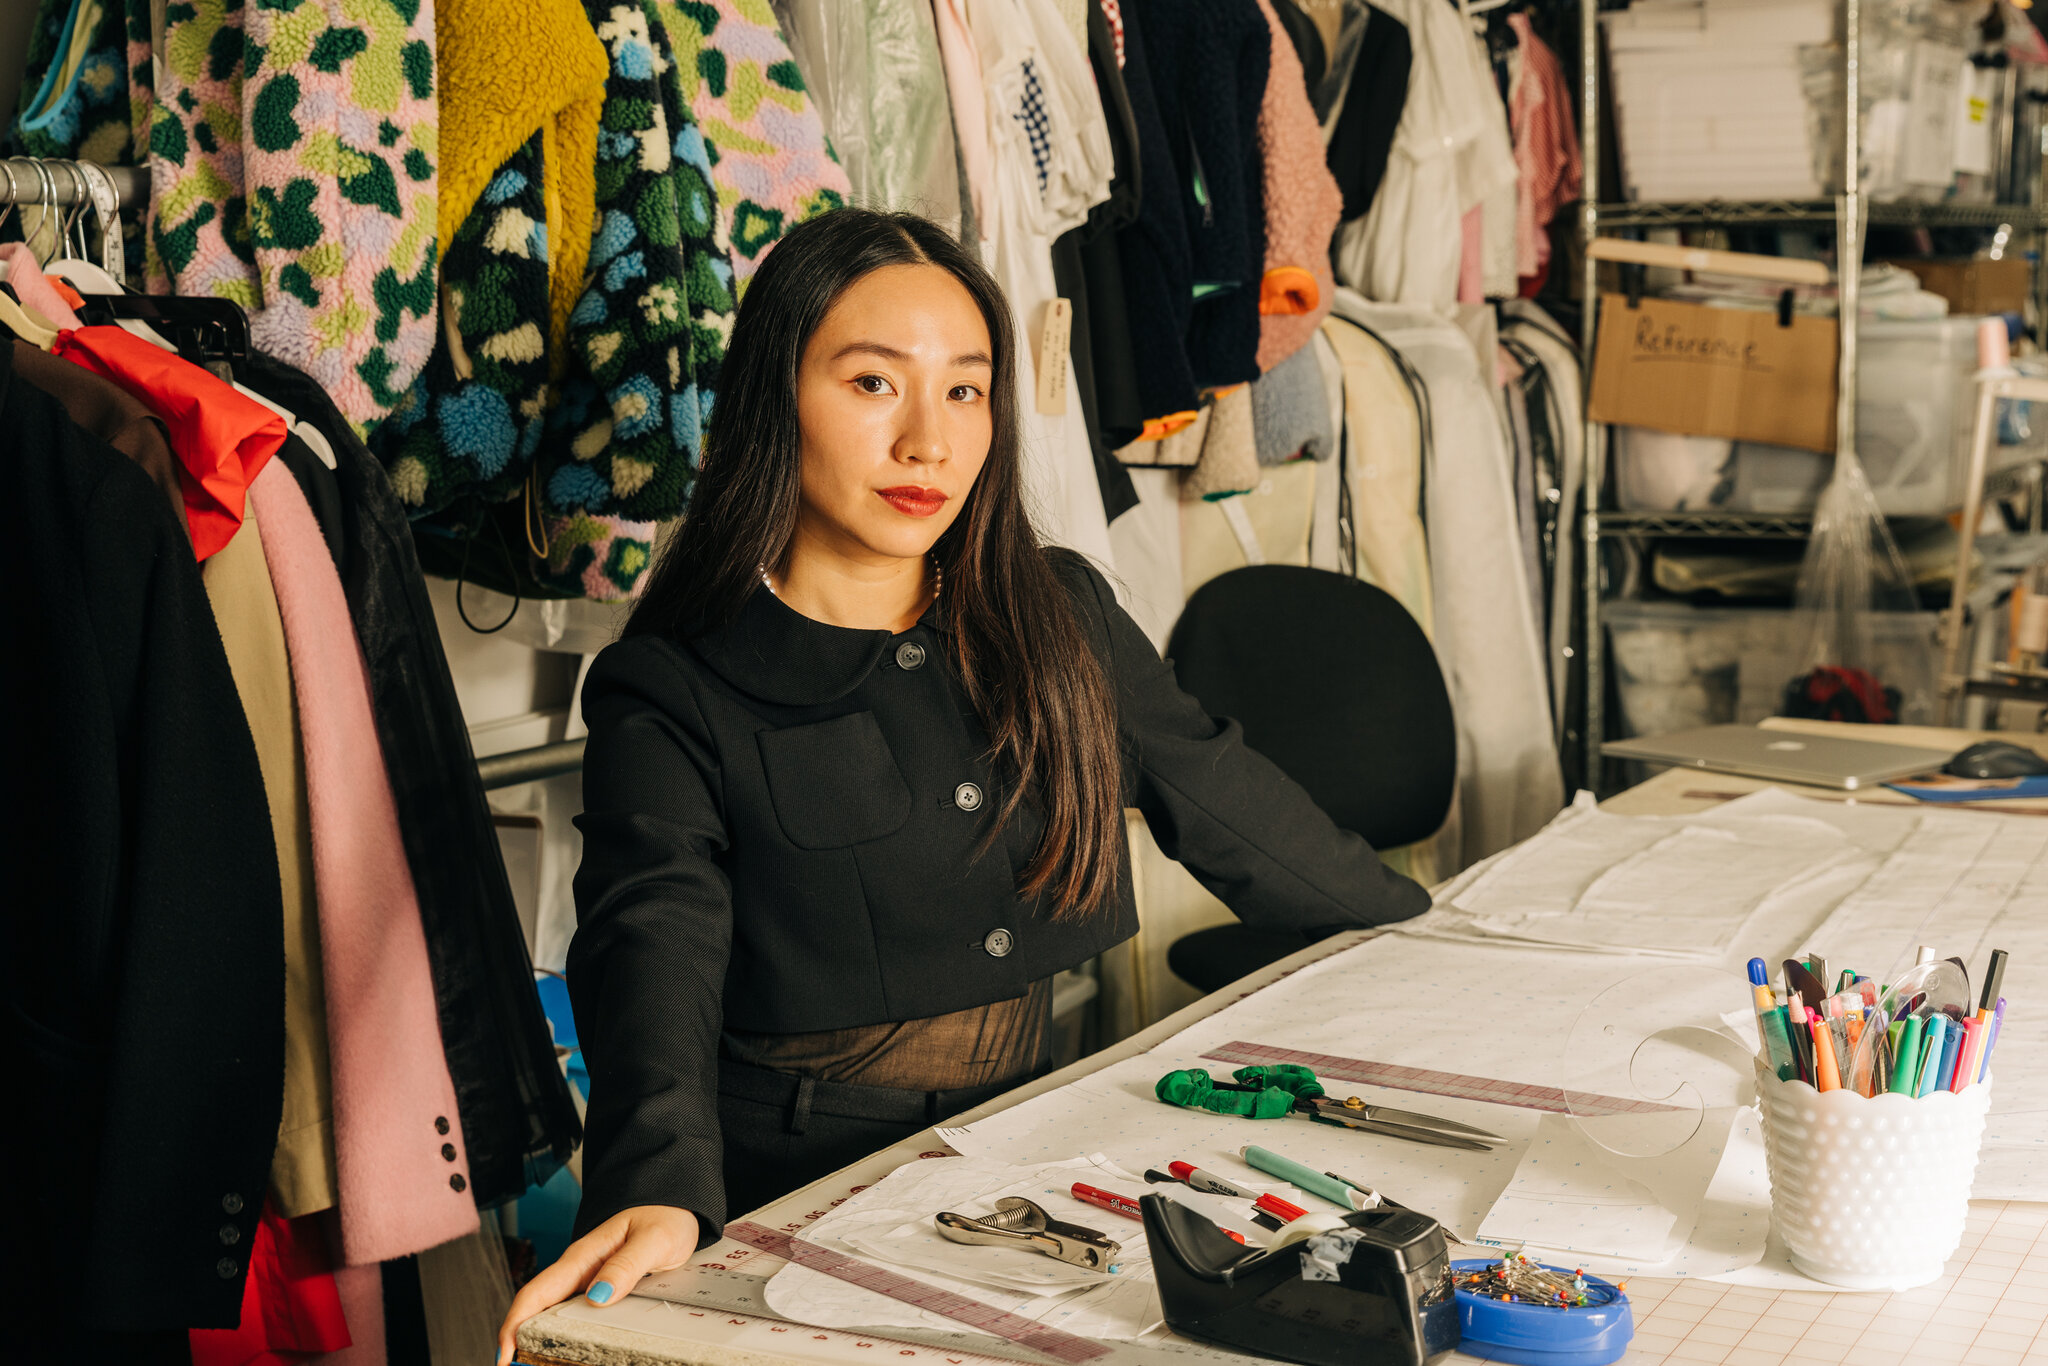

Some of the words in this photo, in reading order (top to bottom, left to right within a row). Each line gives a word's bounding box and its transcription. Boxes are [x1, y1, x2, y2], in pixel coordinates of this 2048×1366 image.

[1634, 315, 1757, 364] Reference
[725, 1249, 750, 1260] 53
[727, 1318, 747, 1326] 2
[856, 1341, 873, 1349] 5
